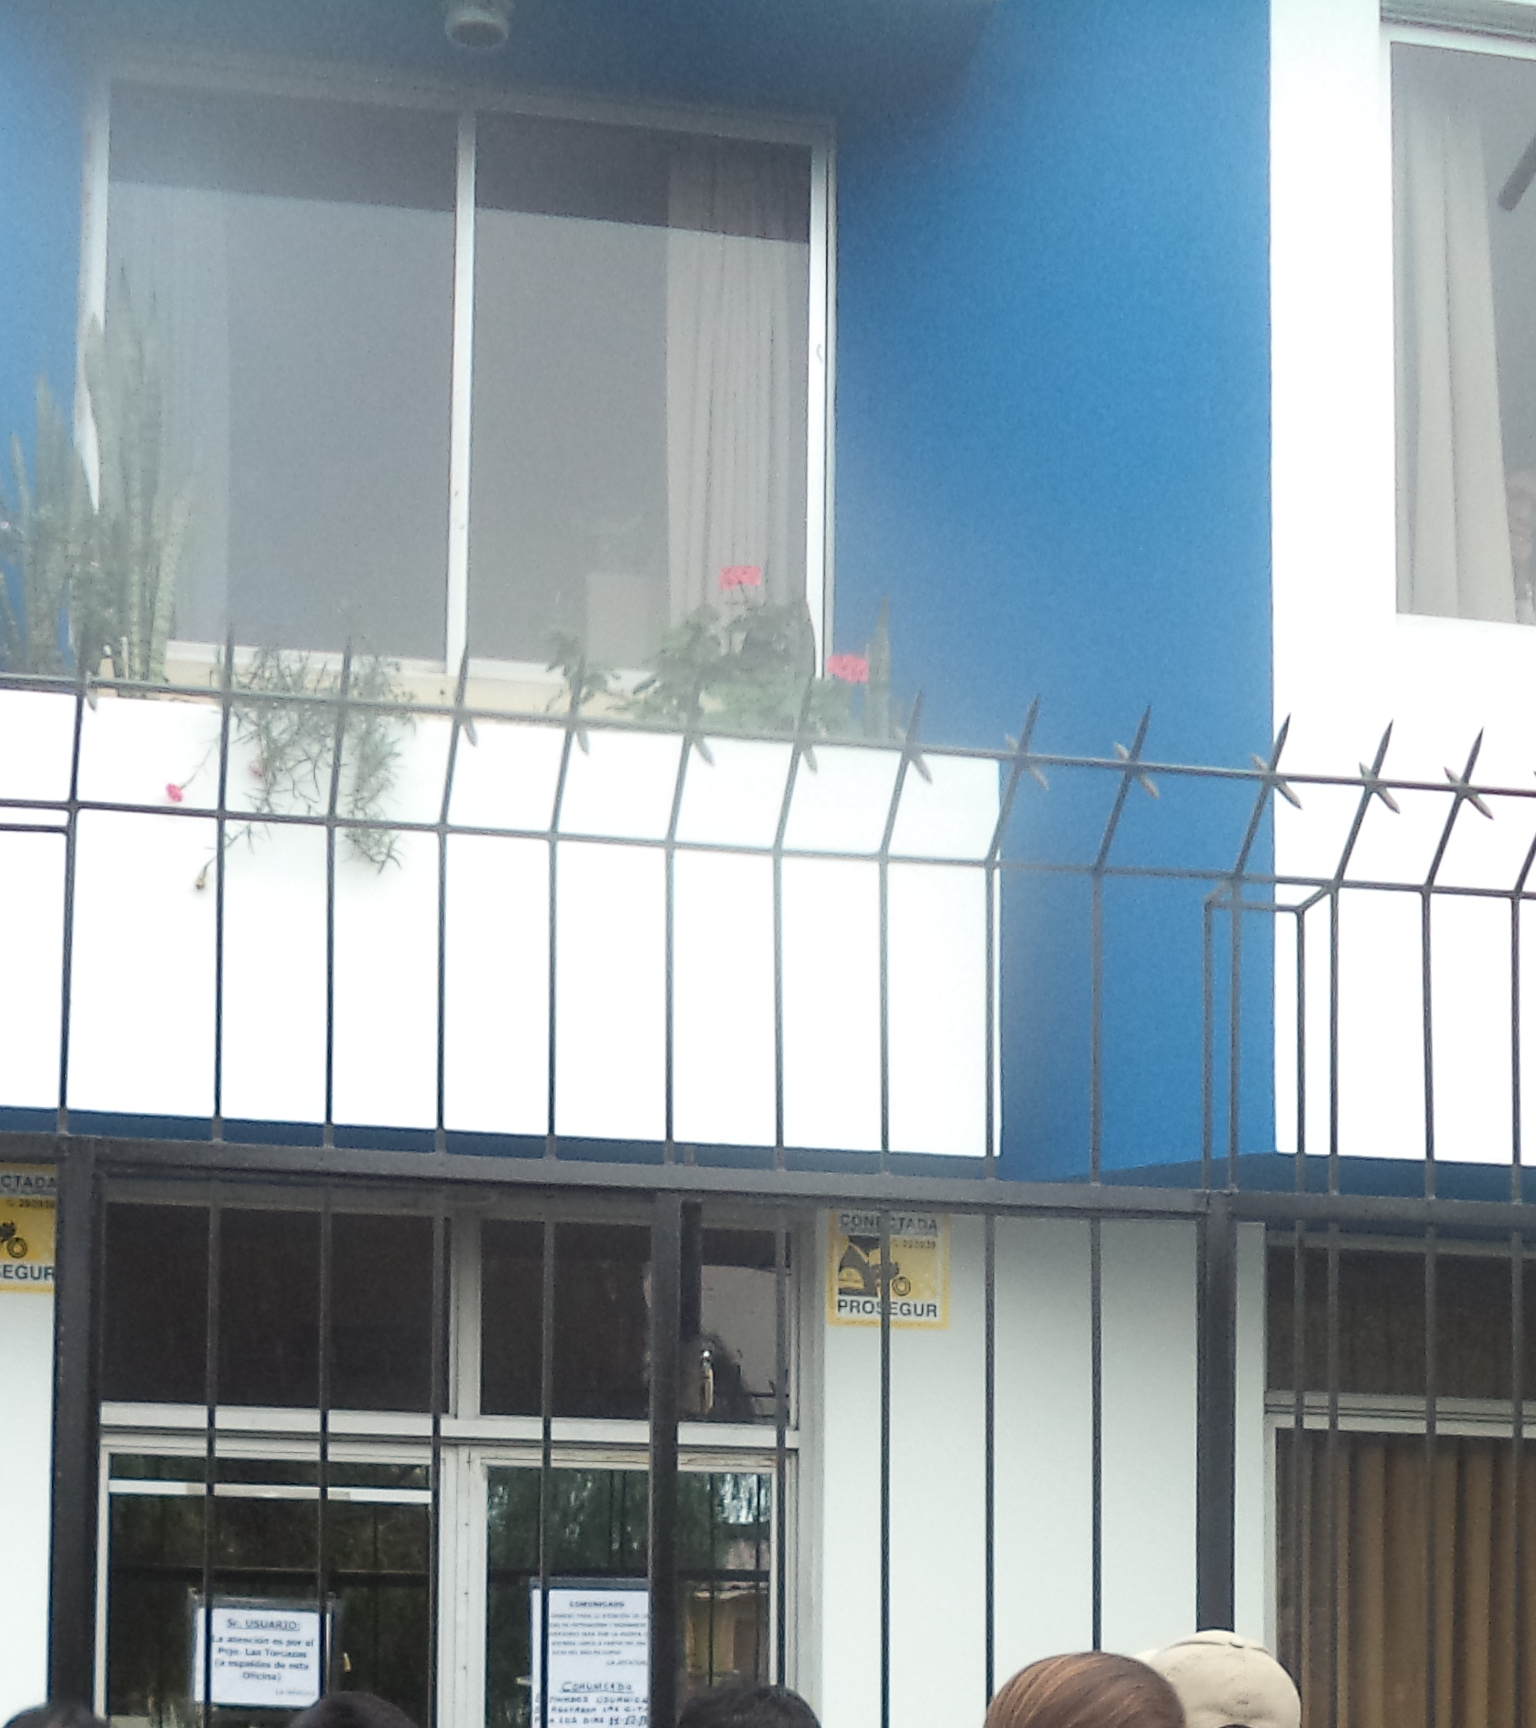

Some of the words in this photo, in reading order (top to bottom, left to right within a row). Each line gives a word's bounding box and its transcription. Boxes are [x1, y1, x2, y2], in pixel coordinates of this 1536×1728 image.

[245, 1619, 301, 1632] USUARIO:
[305, 1638, 314, 1647] el
[274, 1661, 285, 1669] de
[561, 1681, 632, 1692] COMUNICADO
